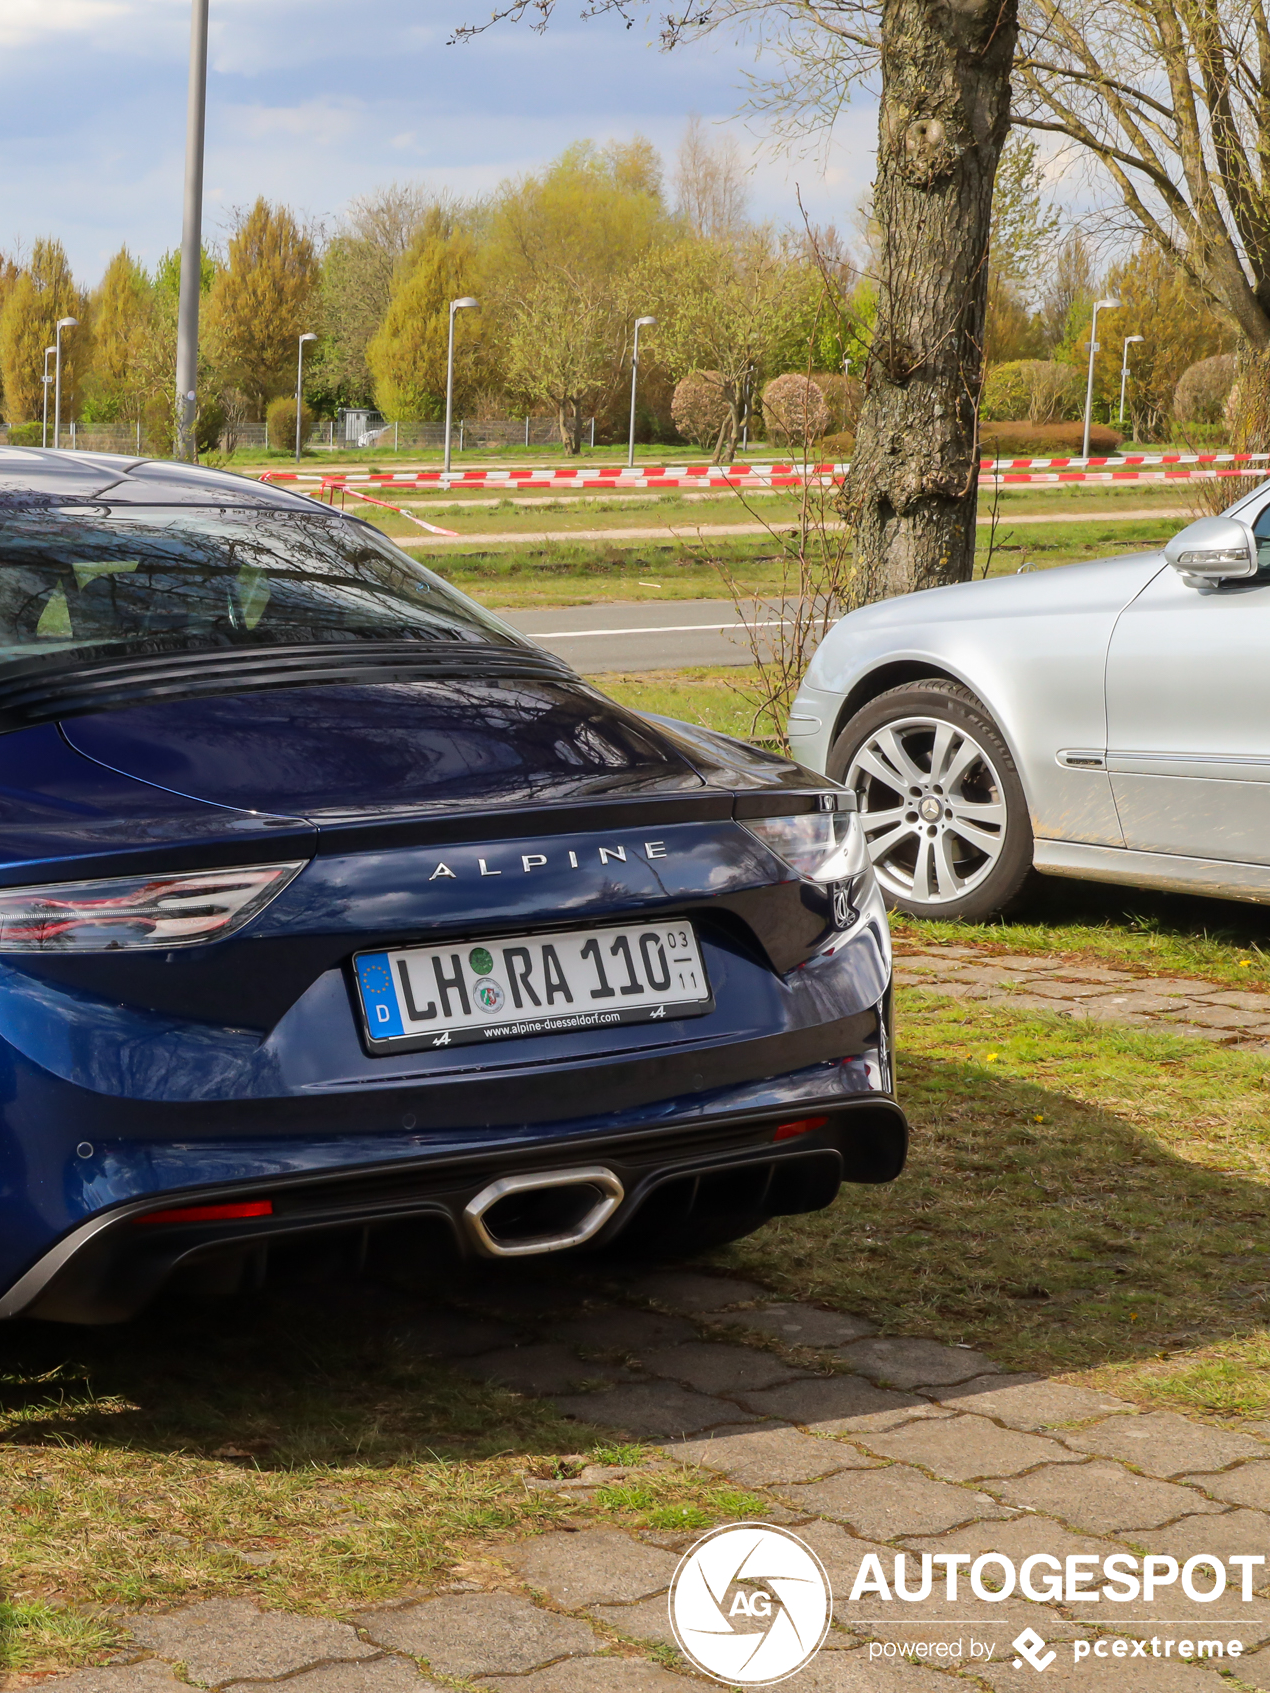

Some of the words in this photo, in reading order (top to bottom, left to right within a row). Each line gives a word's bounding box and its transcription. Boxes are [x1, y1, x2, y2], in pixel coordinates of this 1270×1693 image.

[967, 713, 1015, 770] MICHELIN
[429, 841, 668, 881] ALPINE
[667, 931, 689, 949] 03
[397, 954, 471, 1021] LH
[502, 944, 574, 1008] RA
[580, 932, 671, 999] 110
[679, 972, 698, 989] 11
[376, 1004, 390, 1022] D
[483, 1013, 621, 1038] www.alpine-duesseldorf.com
